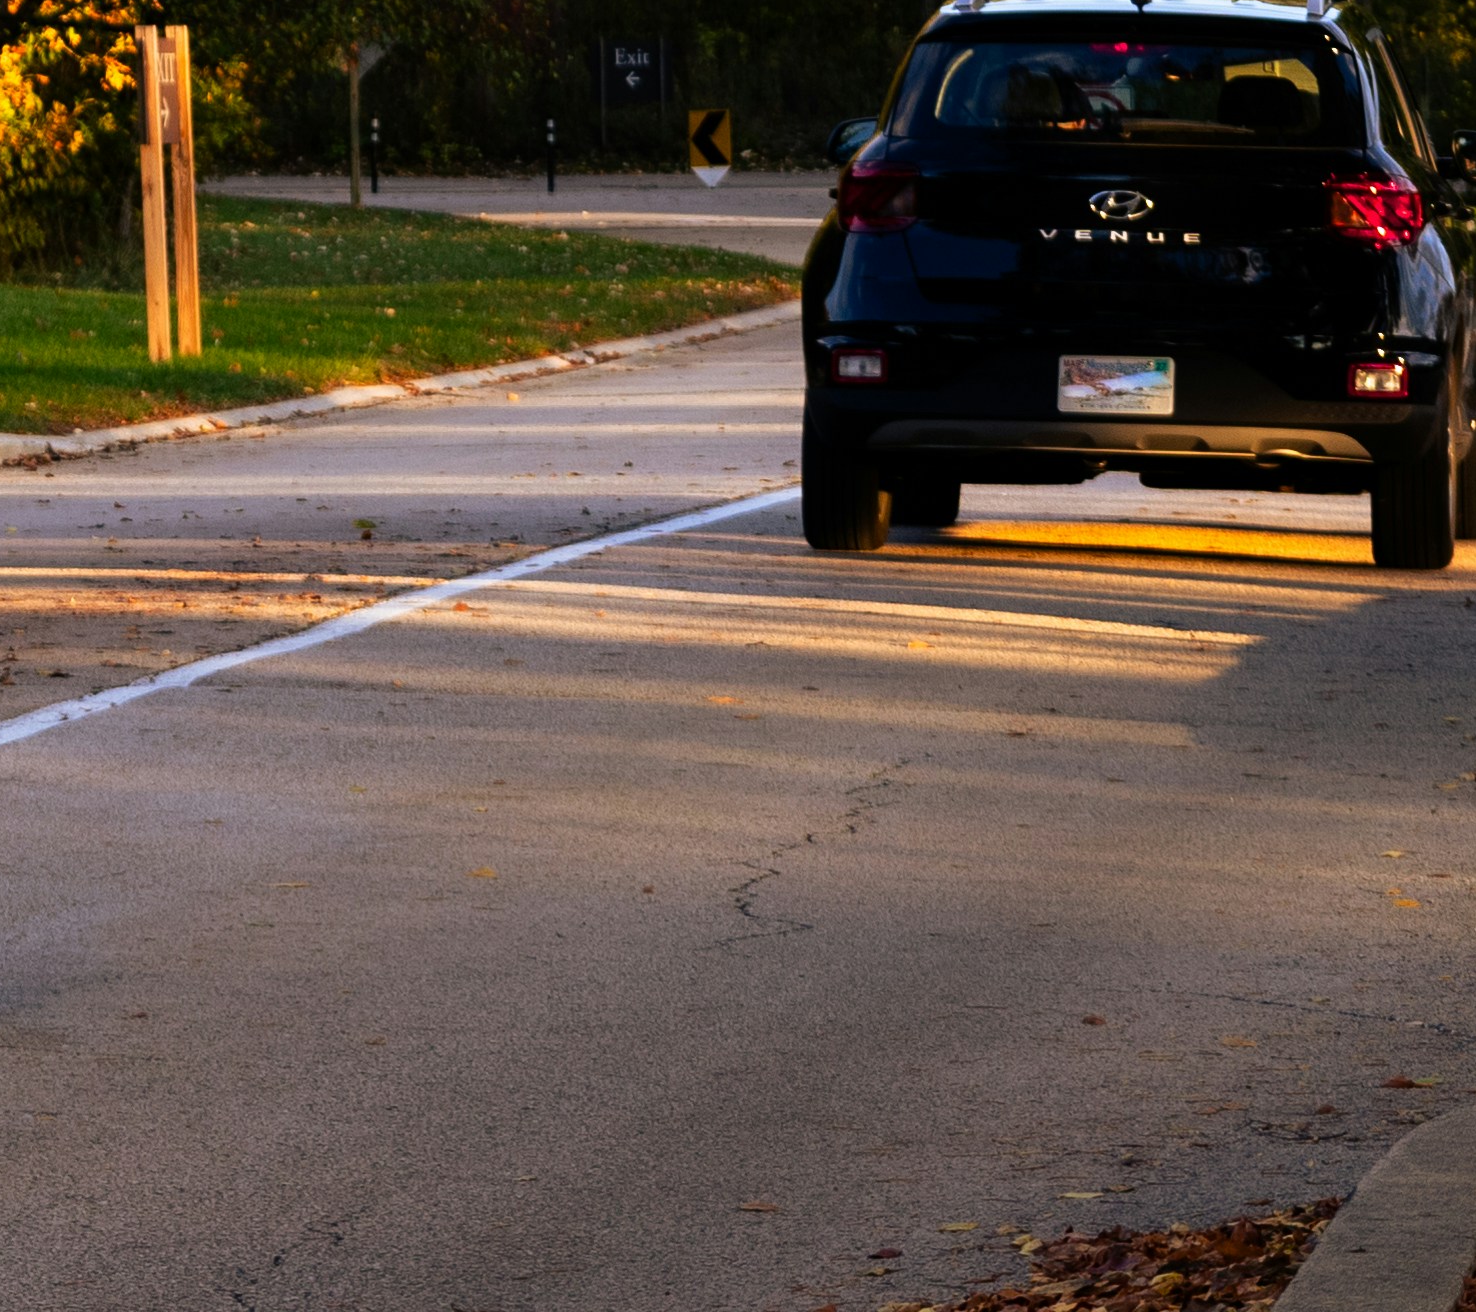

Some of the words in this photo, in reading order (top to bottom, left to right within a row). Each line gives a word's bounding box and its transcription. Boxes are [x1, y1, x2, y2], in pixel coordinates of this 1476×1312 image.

[615, 47, 650, 66] Exit
[157, 52, 176, 82] XIT
[1039, 228, 1201, 244] VENUE
